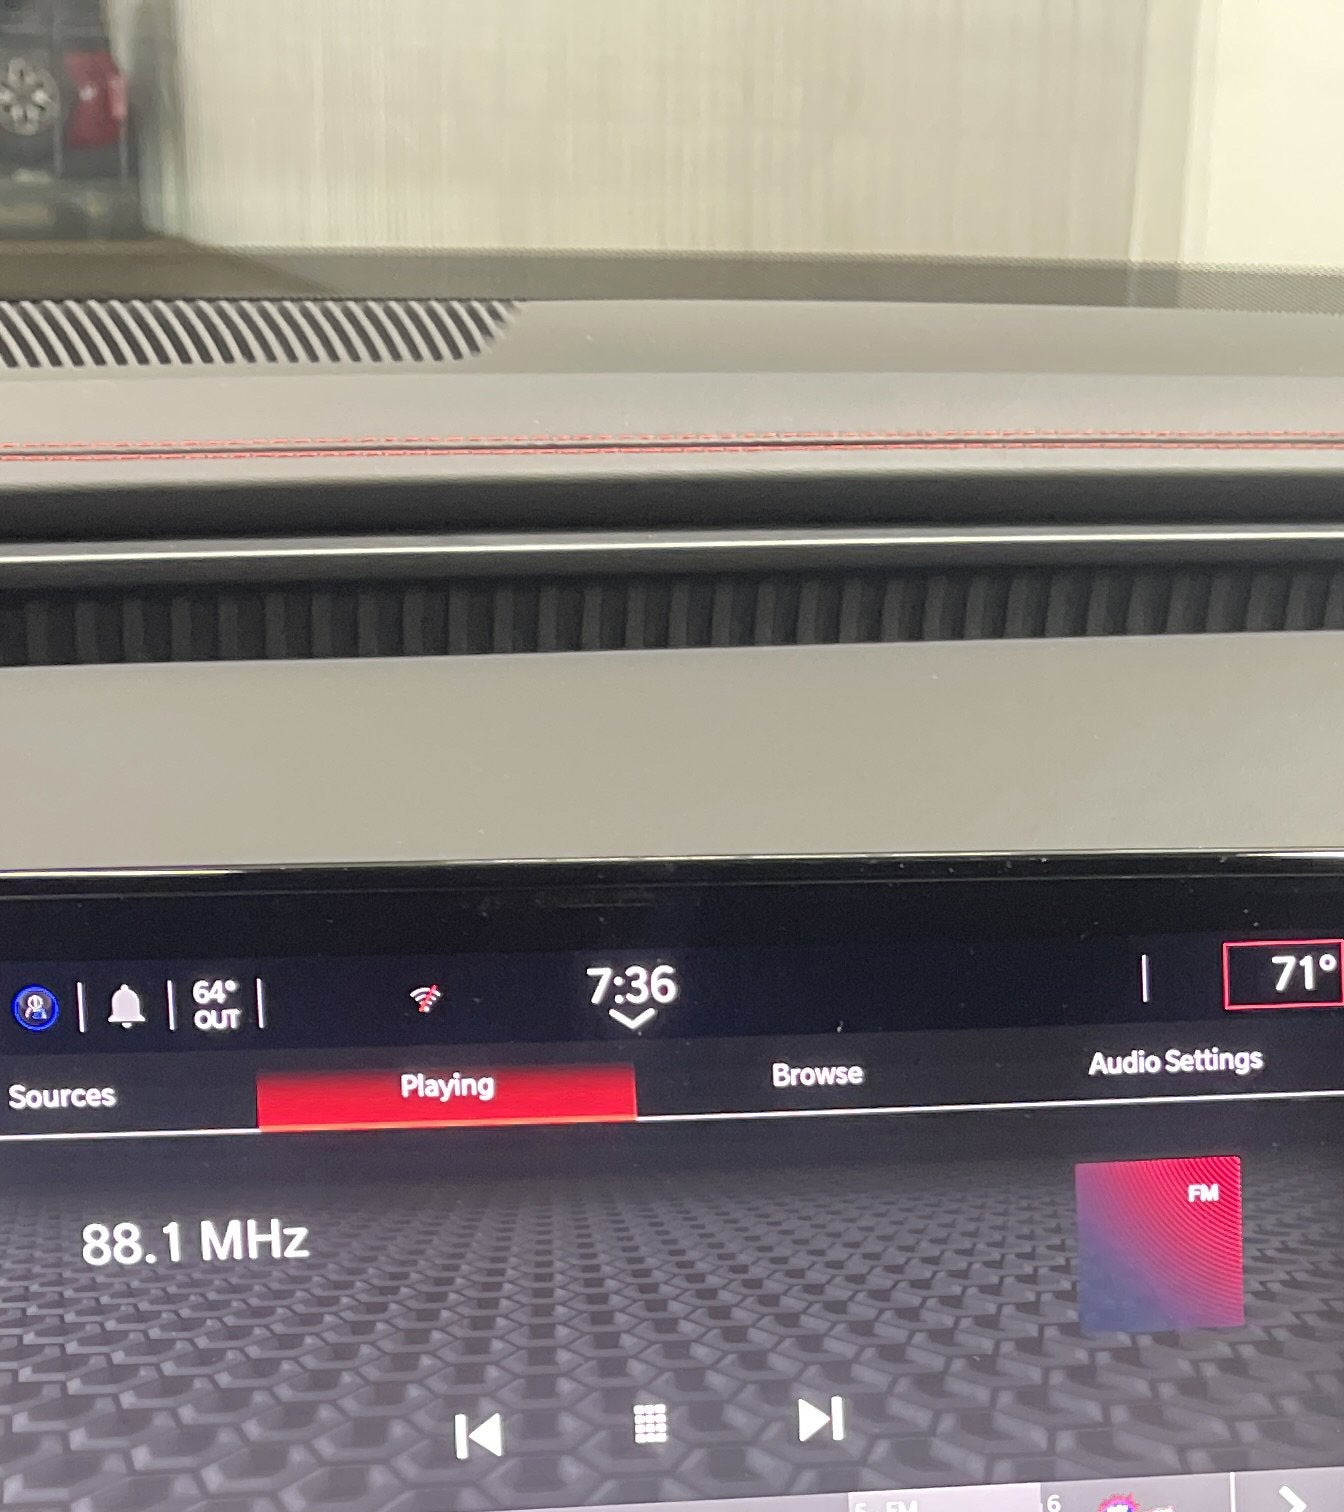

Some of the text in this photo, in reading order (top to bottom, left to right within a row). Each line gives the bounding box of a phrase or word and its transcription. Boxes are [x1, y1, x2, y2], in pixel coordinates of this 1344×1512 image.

[586, 964, 678, 1005] 7:36
[1271, 952, 1338, 993] 71°
[191, 978, 238, 1004] 64°
[193, 1007, 242, 1030] OUT
[771, 1062, 865, 1088] Browse
[1087, 1046, 1265, 1076] Audio Settings
[8, 1083, 117, 1110] Sources
[400, 1072, 496, 1103] Playing
[1187, 1183, 1220, 1203] FM
[81, 1218, 311, 1266] 88.1 MHz
